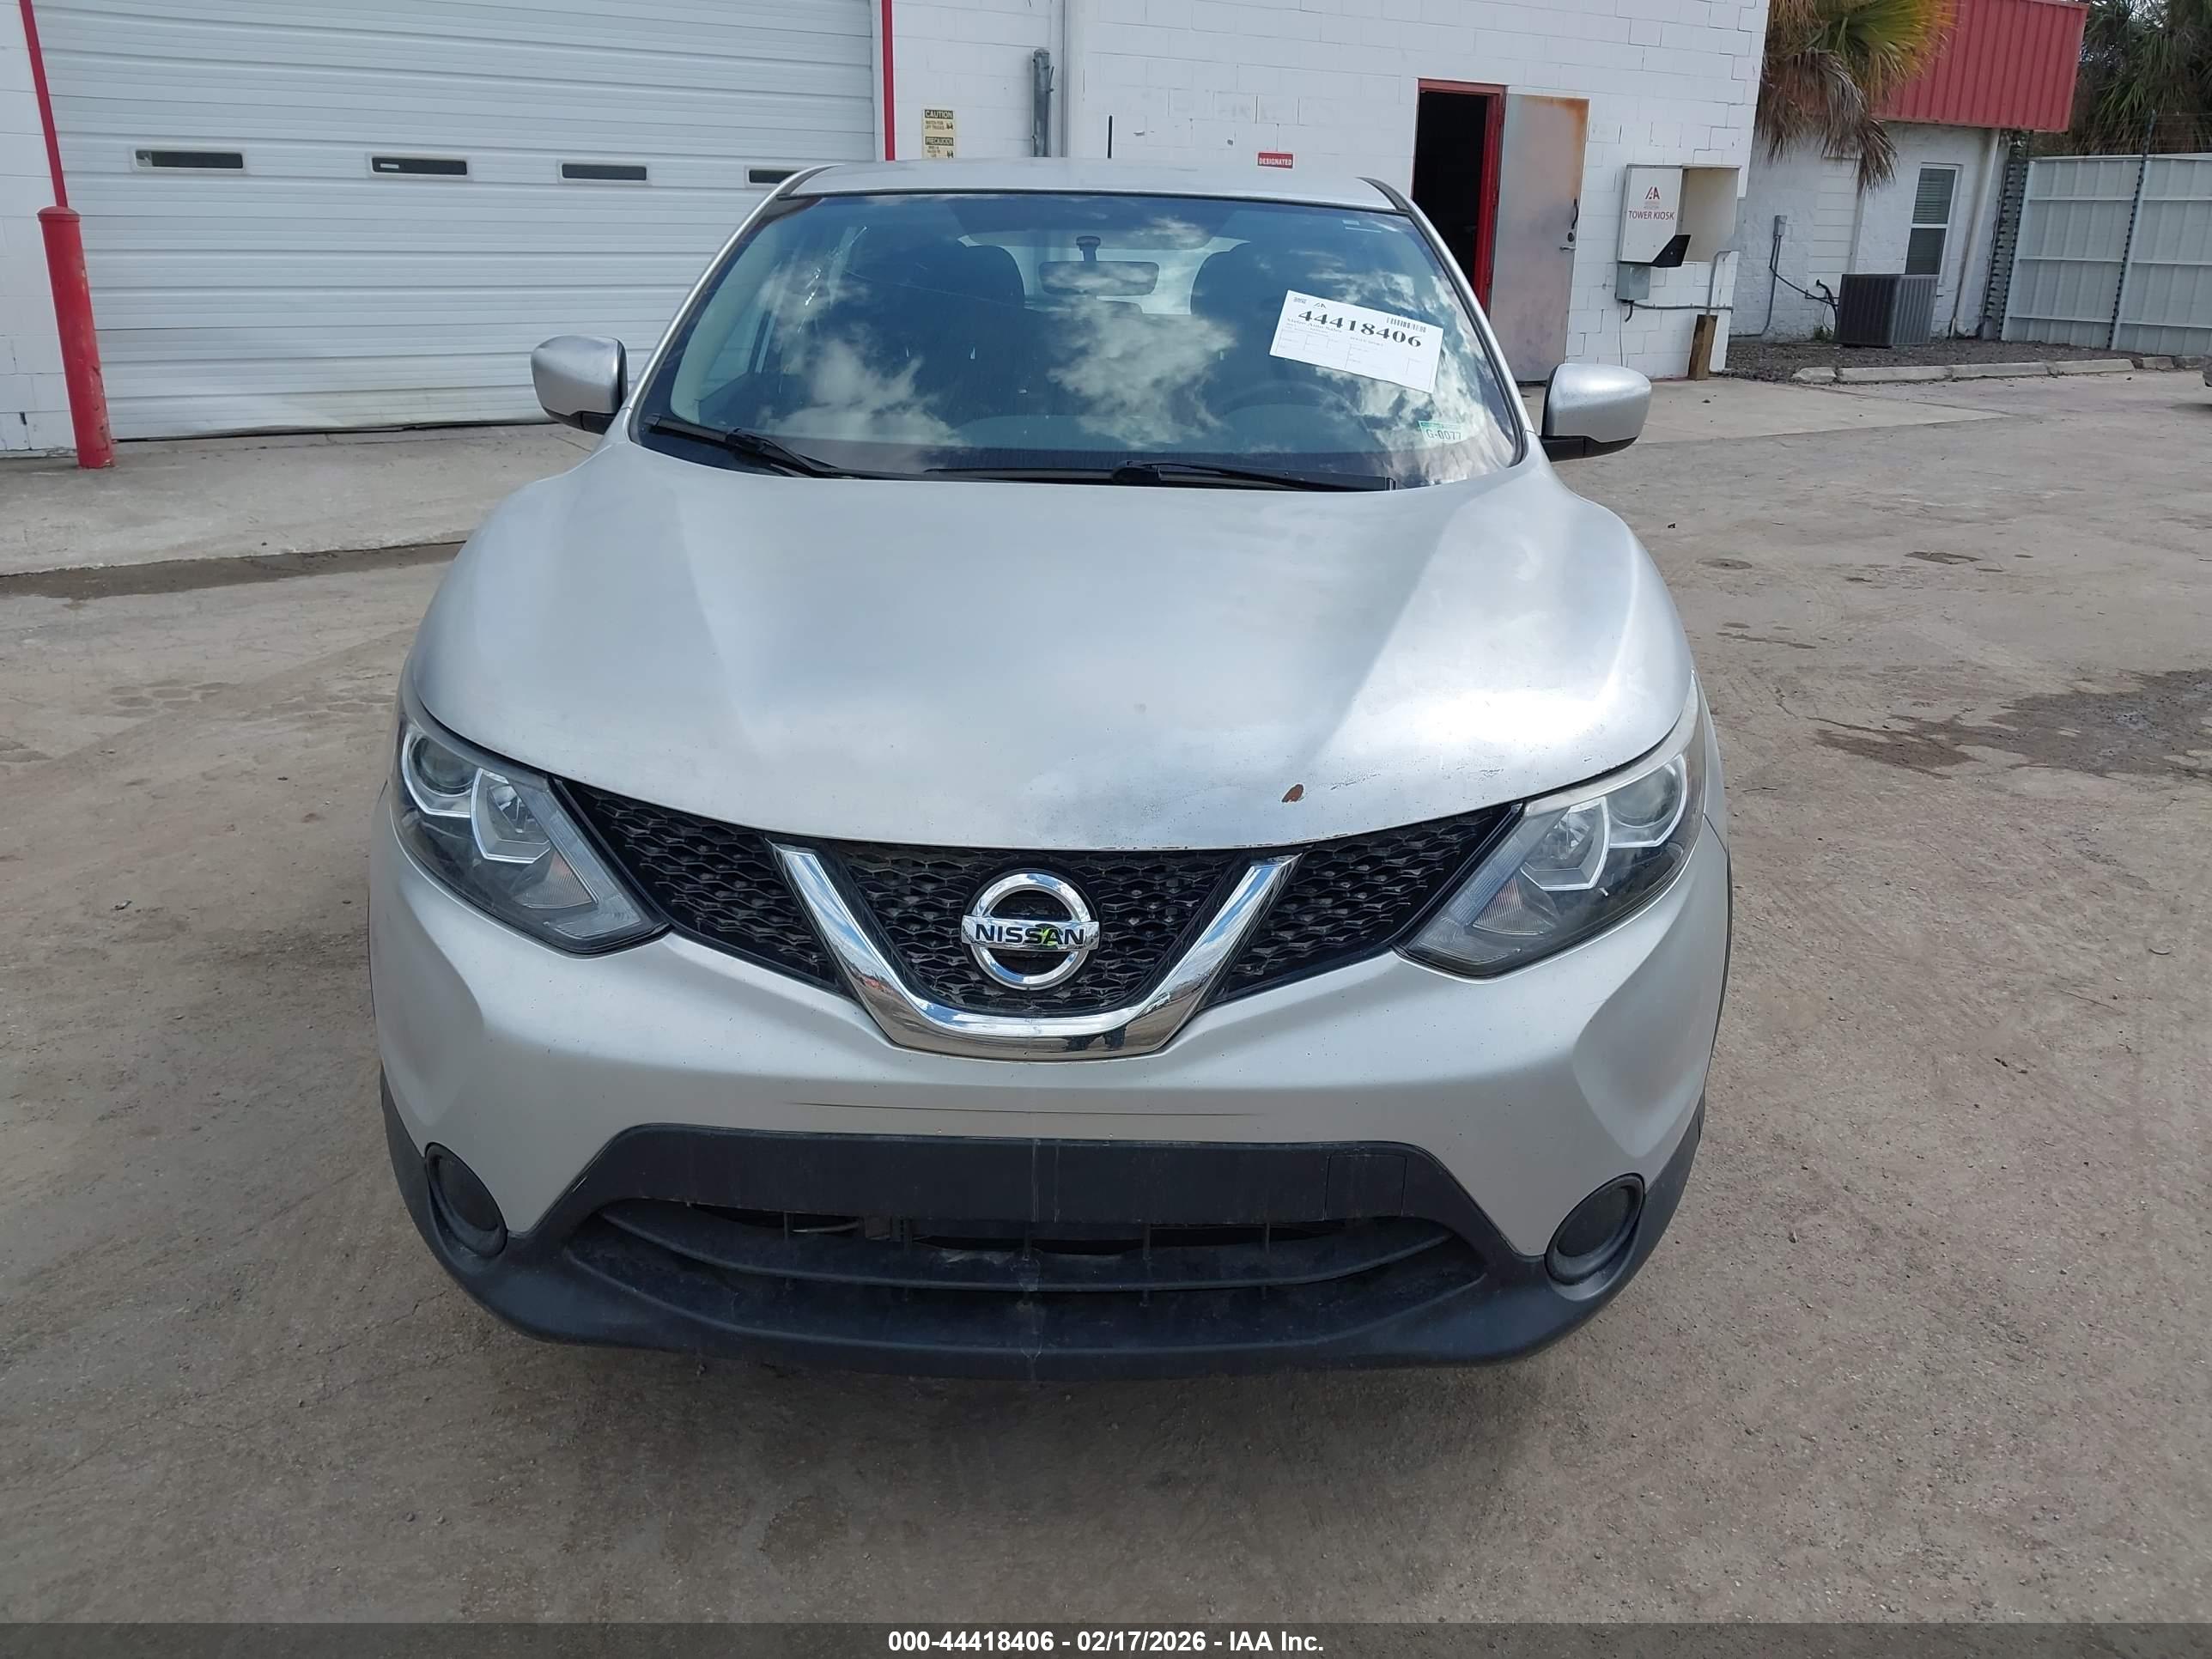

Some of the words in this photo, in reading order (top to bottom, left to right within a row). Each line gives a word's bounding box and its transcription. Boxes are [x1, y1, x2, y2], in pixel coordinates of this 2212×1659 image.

[1628, 210, 1652, 220] TOWER
[1653, 211, 1674, 221] KIOSK
[1298, 310, 1422, 348] 44418406
[975, 923, 1085, 945] NISSAN
